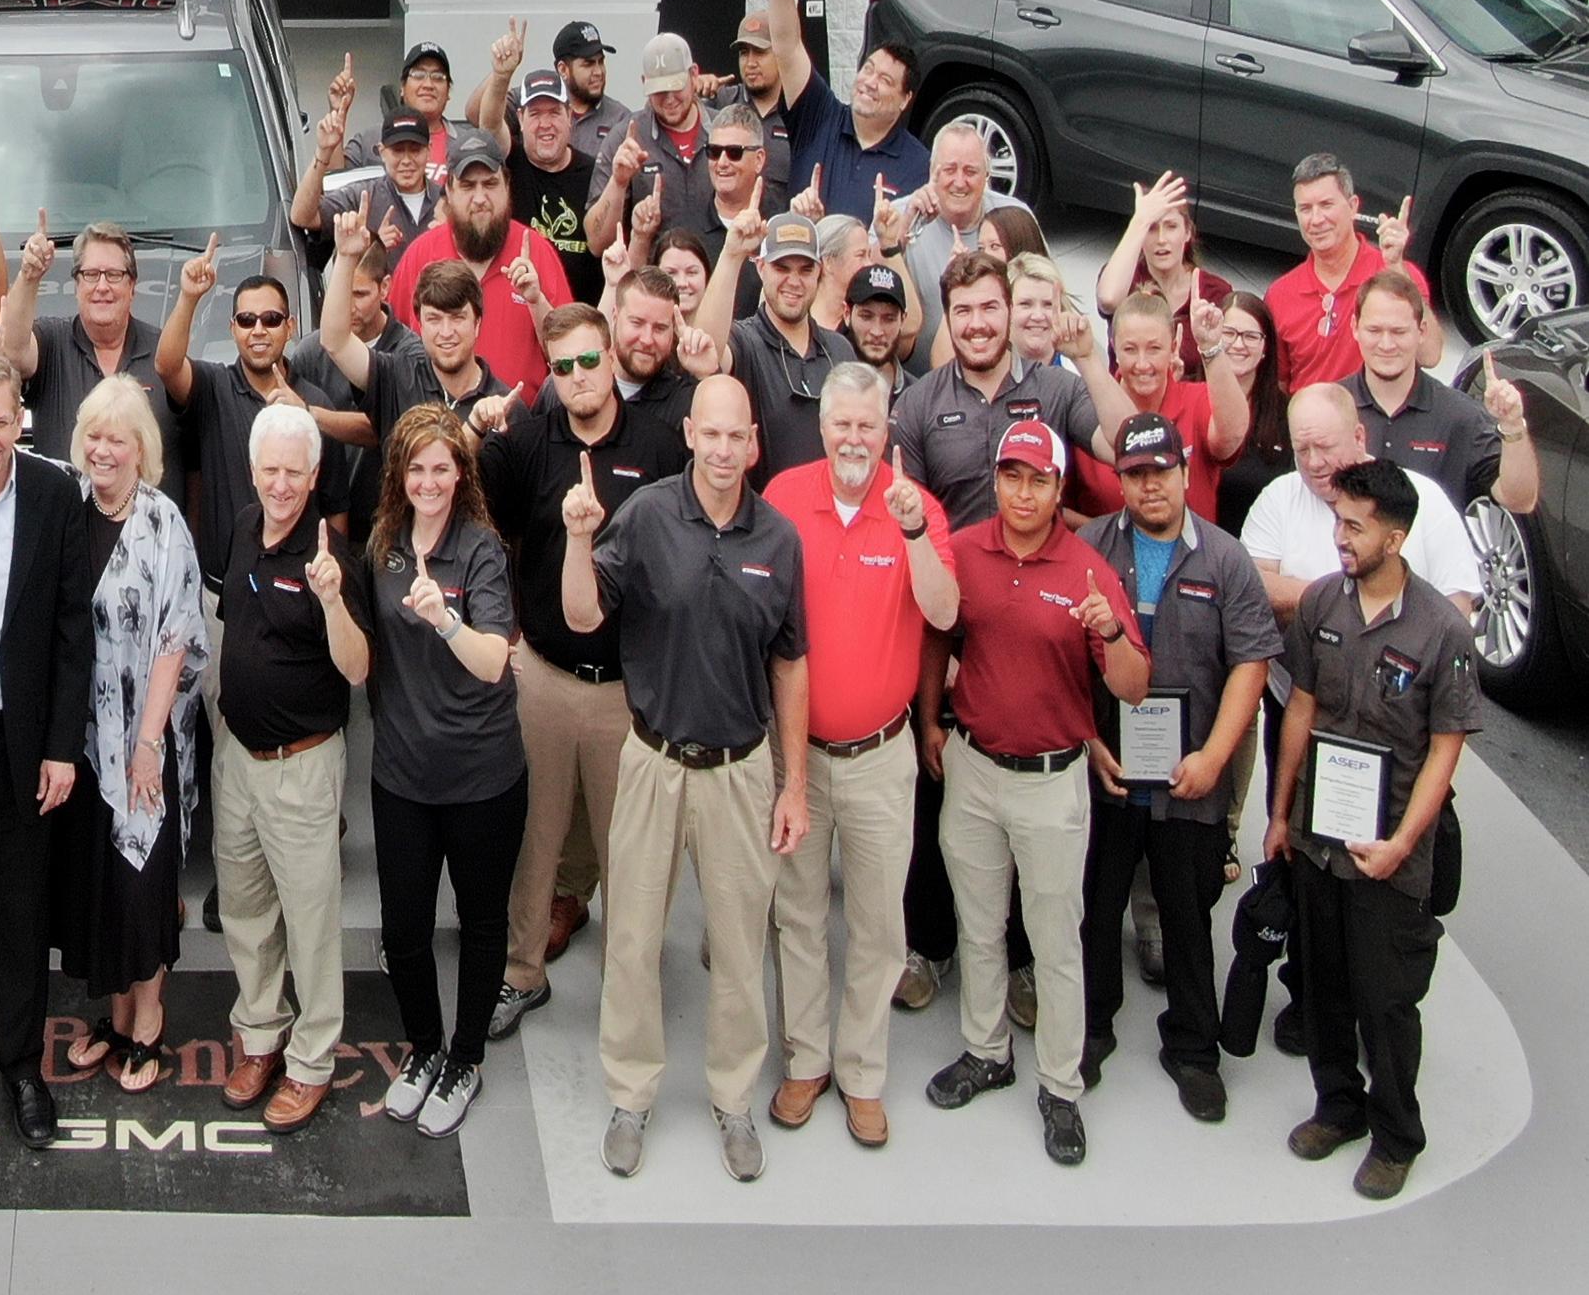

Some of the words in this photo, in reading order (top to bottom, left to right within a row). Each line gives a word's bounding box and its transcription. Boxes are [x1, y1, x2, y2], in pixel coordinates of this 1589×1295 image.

[1130, 705, 1170, 715] ASEP
[1327, 755, 1370, 771] ASEP
[45, 1118, 273, 1153] GMC
